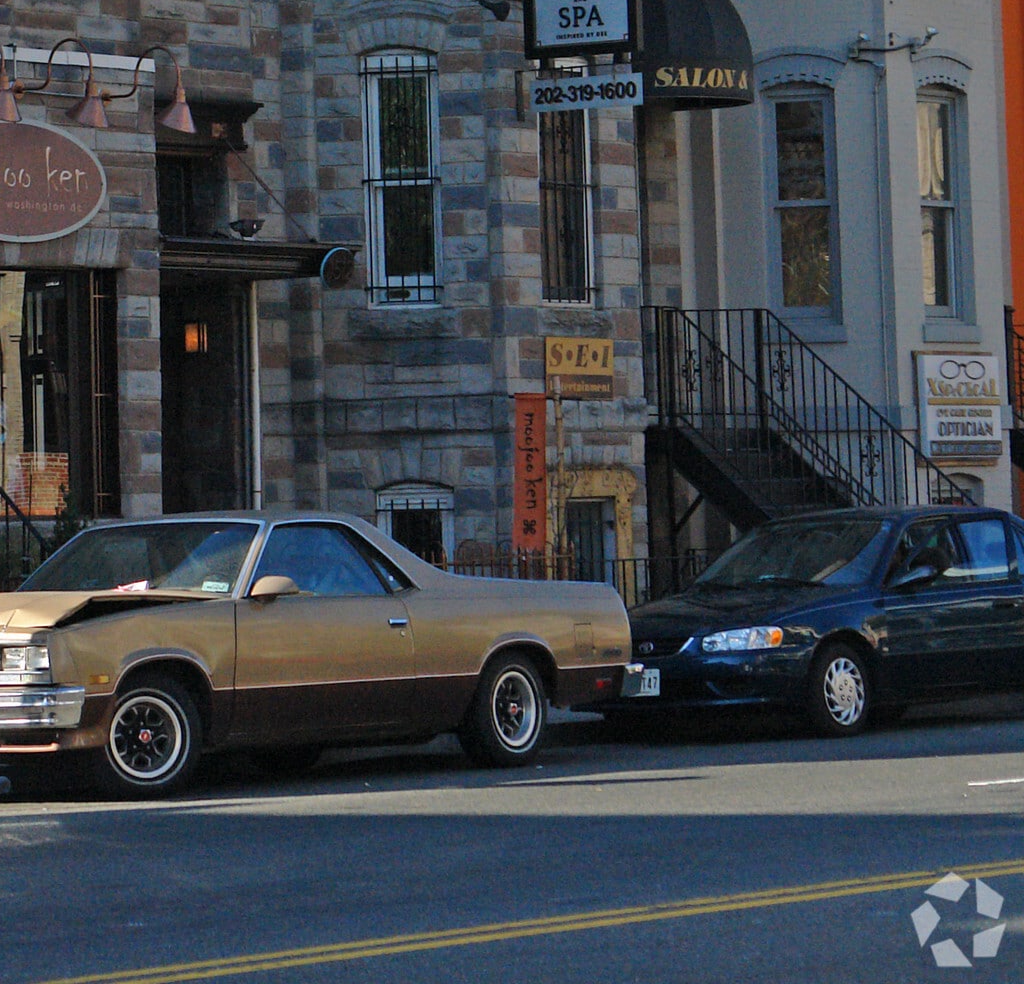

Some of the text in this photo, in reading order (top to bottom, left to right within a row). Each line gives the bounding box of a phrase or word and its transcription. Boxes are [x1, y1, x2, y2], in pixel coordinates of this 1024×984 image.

[558, 4, 605, 28] SPA
[654, 66, 736, 89] SALON
[534, 80, 637, 106] 202-319-1600
[937, 420, 994, 436] OPTICIAN
